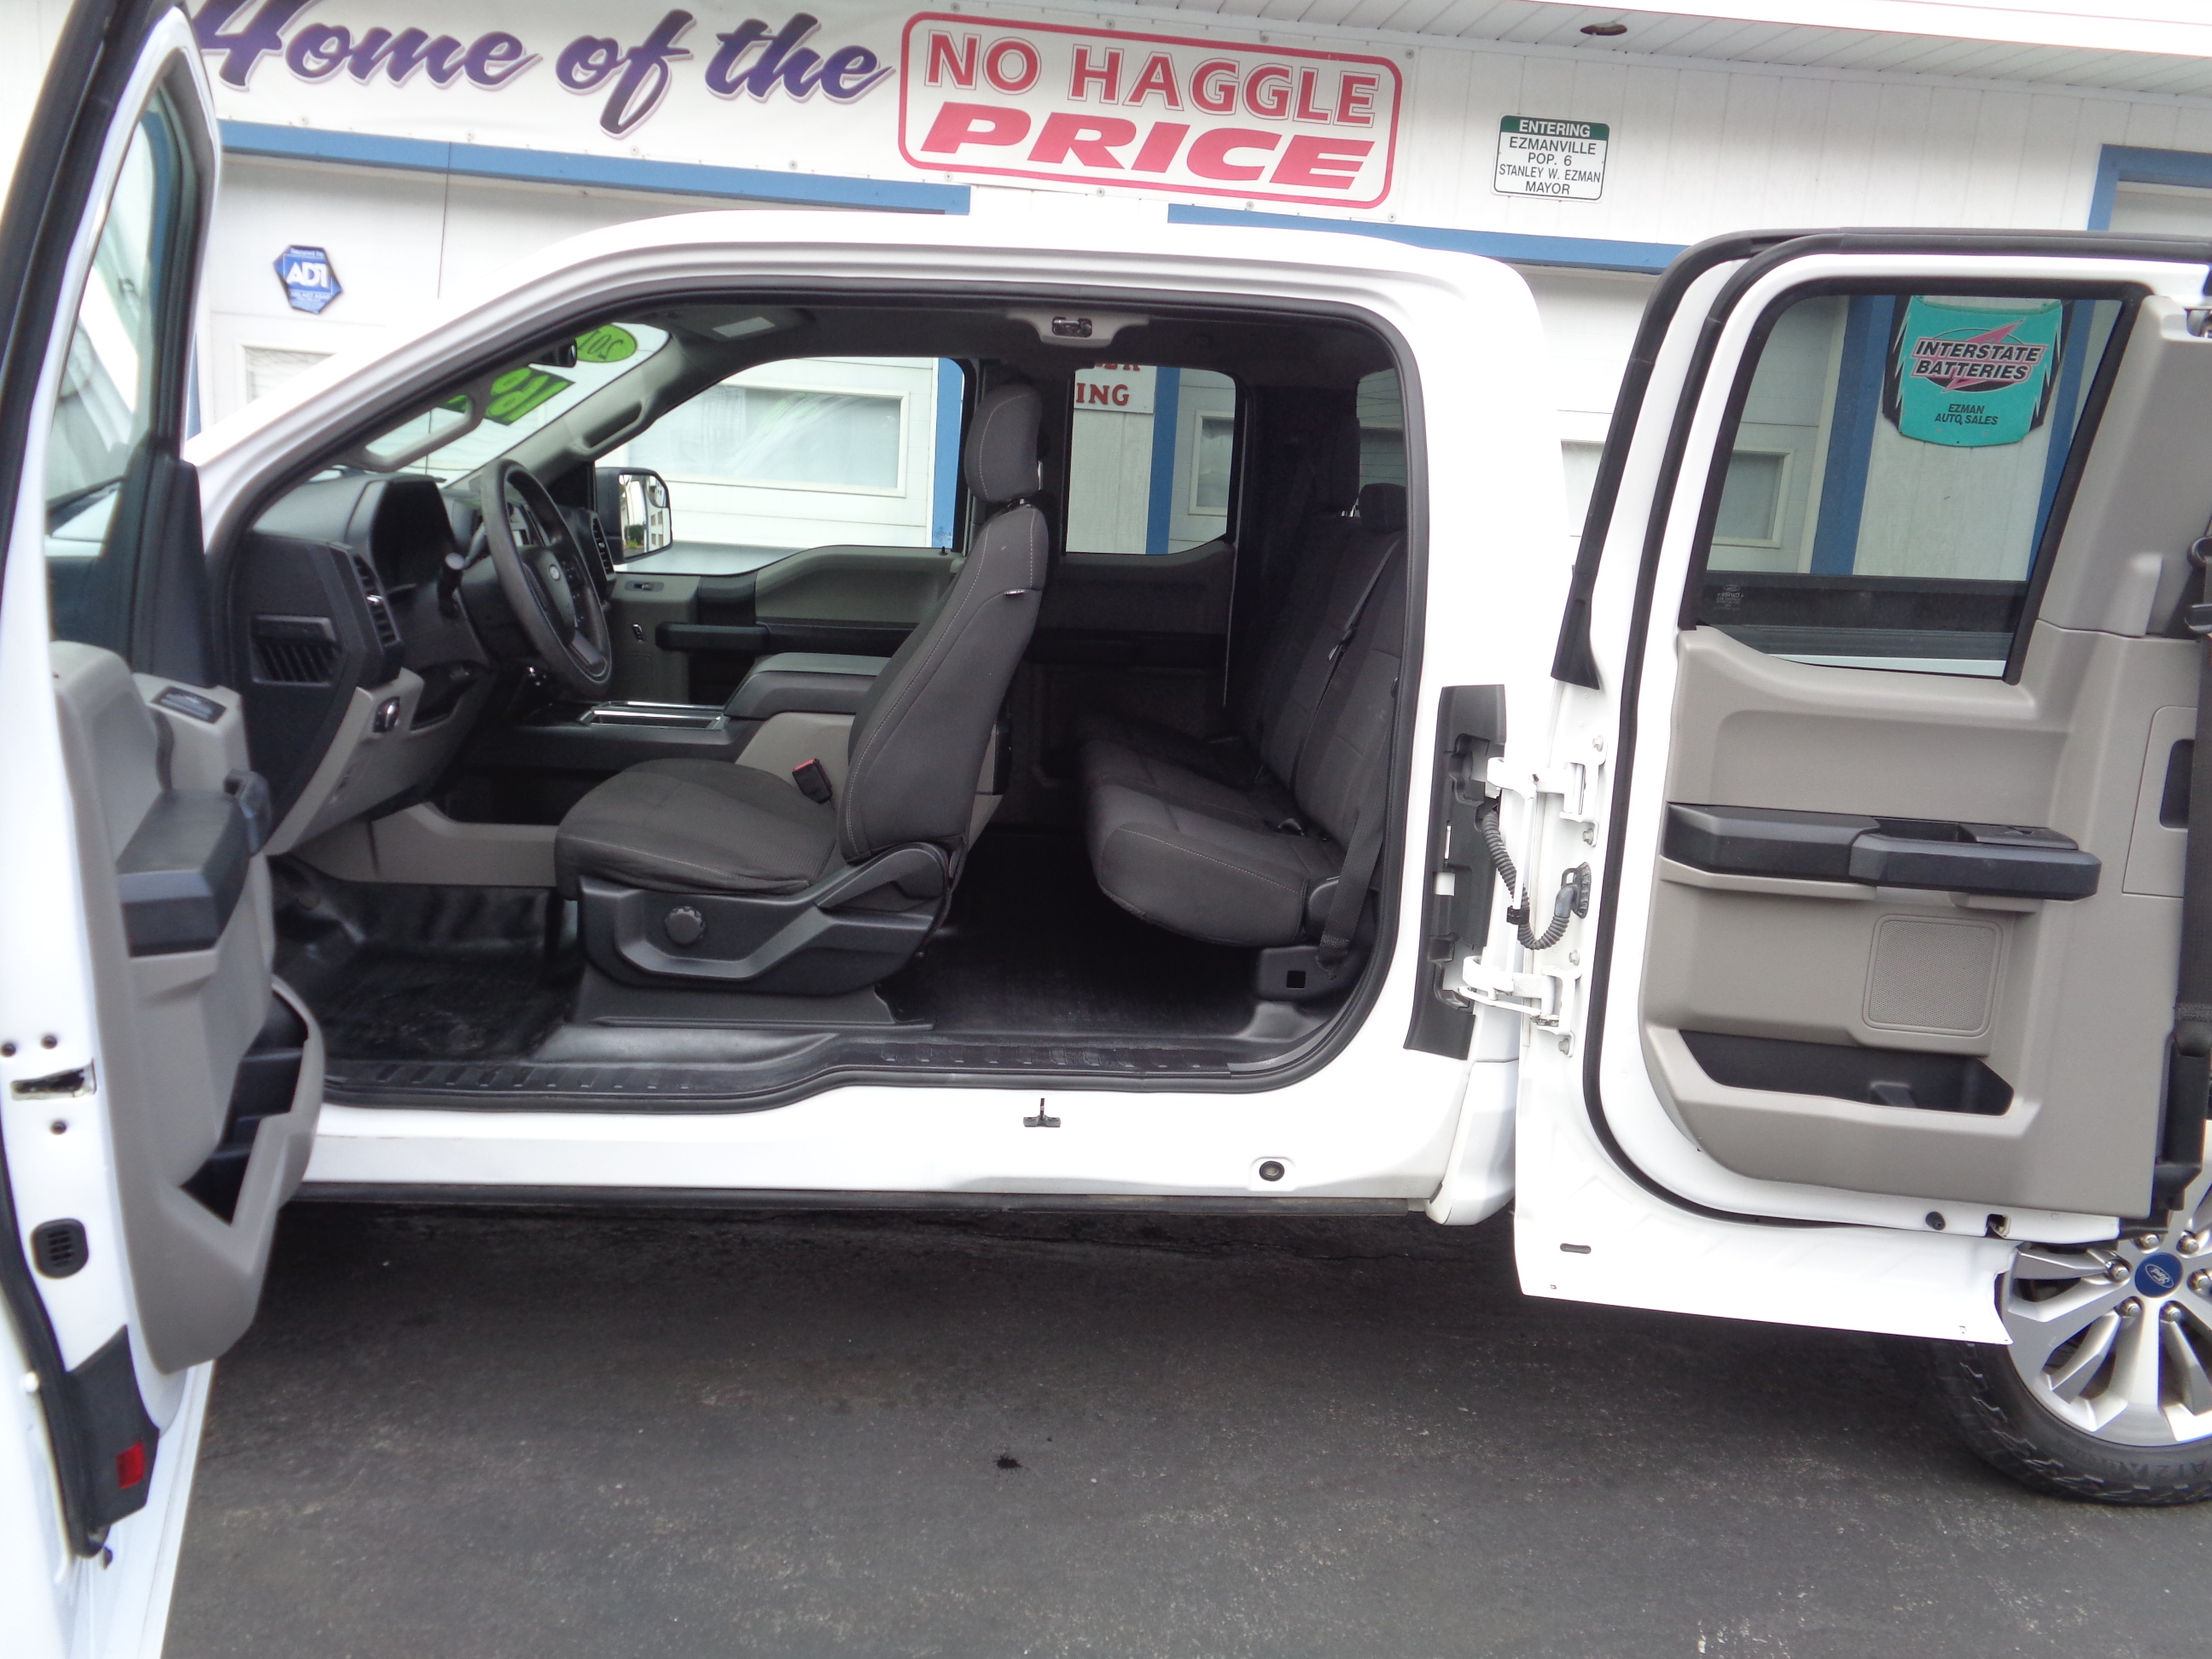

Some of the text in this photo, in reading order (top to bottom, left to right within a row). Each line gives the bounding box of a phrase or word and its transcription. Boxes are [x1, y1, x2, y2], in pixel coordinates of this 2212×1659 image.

[191, 0, 896, 140] Home of the
[924, 29, 1381, 128] NO HAGGLE
[1519, 119, 1591, 137] ENTERING
[920, 101, 1375, 190] PRICE
[1509, 137, 1597, 154] EZMANVILLE
[1528, 152, 1572, 166] POP. 6
[1499, 164, 1601, 183] STANLEY W. EZMAN
[1525, 181, 1570, 195] MAYOR
[285, 261, 329, 288] ADT
[1916, 341, 2041, 362] INTERSTATE
[1916, 360, 2029, 381] BATTERIES
[1075, 382, 1130, 406] ING
[1948, 404, 1986, 414] EZMAN
[1935, 413, 1999, 426] AUTO SALES
